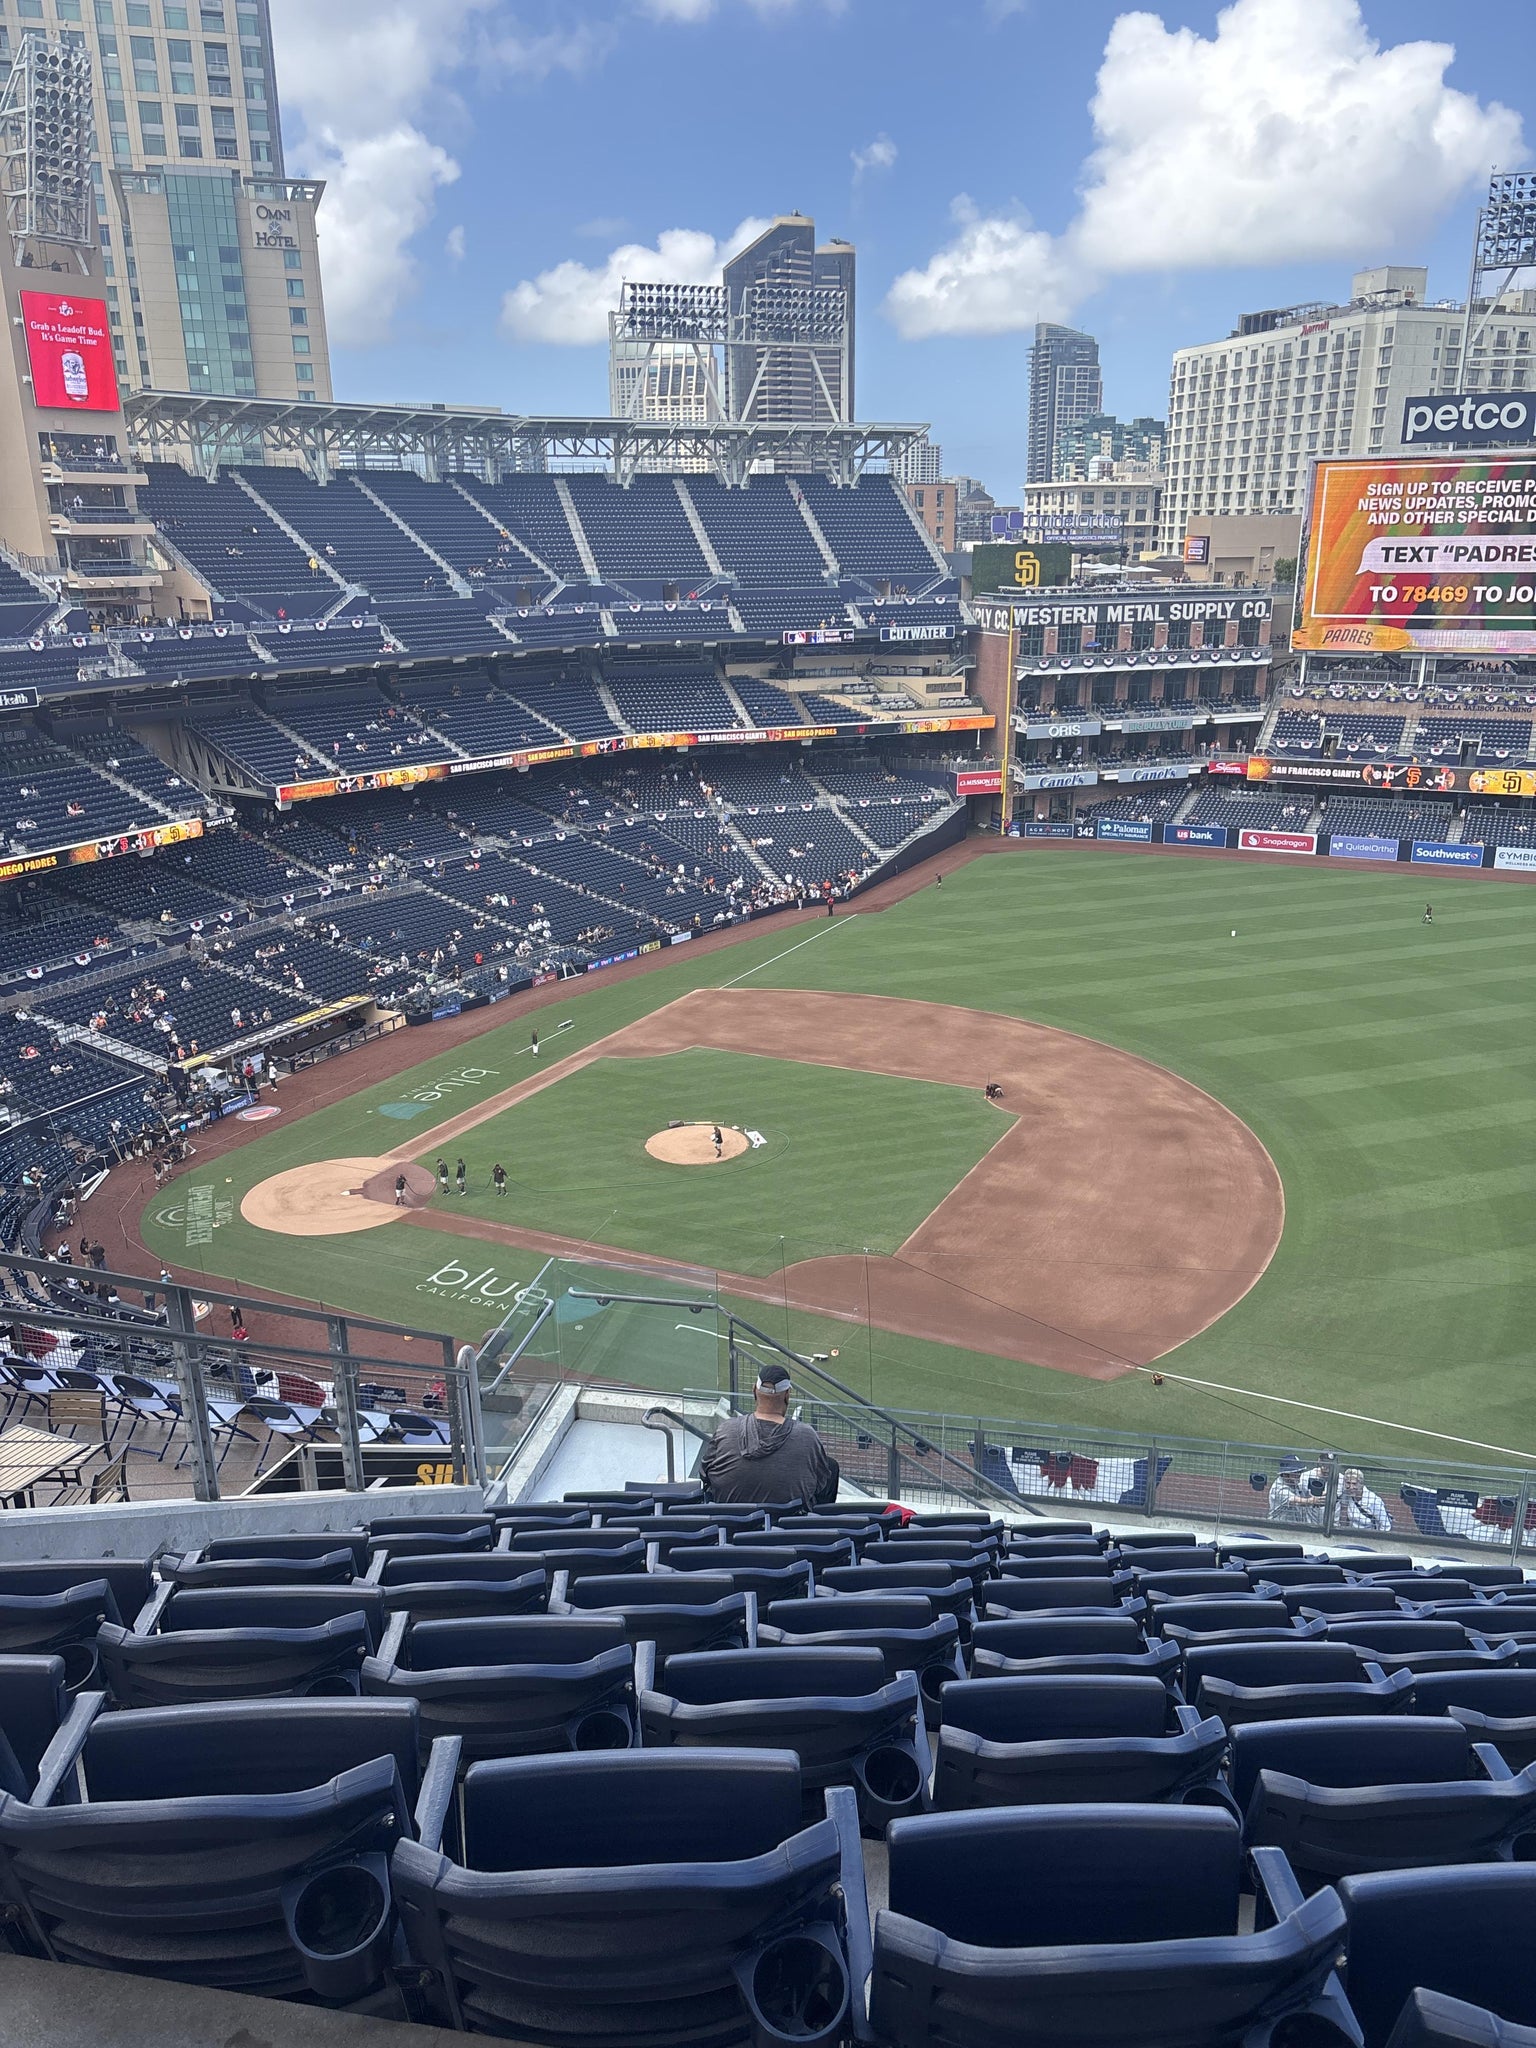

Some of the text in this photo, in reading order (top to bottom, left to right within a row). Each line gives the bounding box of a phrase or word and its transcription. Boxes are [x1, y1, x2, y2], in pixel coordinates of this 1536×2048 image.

[256, 204, 291, 221] OMNI
[255, 231, 297, 248] HOTEL
[30, 321, 49, 330] Grab
[58, 323, 86, 335] Leadoff
[55, 334, 76, 344] Game
[78, 336, 98, 346] Time
[1405, 397, 1527, 441] petco
[1367, 483, 1403, 496] SIGN
[1407, 482, 1428, 495] UP
[1431, 482, 1451, 494] TO
[1454, 480, 1522, 494] RECEIVE
[1358, 498, 1401, 512] NEWS
[1405, 496, 1479, 510] UPDATES,
[1028, 514, 1121, 529] QuidelOrtho
[1367, 512, 1400, 525] AND
[1403, 511, 1454, 524] OTHER
[1457, 510, 1524, 524] SPECIAL
[1381, 546, 1438, 562] TEXT
[1369, 586, 1536, 603] TO 78469 TO JO
[1013, 601, 1270, 626] WESTERN METAL SUPPLY CO.
[890, 627, 946, 640] CUTWATER
[1322, 628, 1374, 646] PADRES
[1496, 706, 1532, 714] LANDING
[1048, 724, 1081, 738] ORIS
[1272, 766, 1361, 779] SAN FRANCISCO GIANTS
[1078, 827, 1094, 837] 342
[1113, 824, 1148, 834] Palomar
[1190, 830, 1212, 840] bank
[1262, 837, 1308, 848] Snapdragon
[1346, 842, 1395, 854] QuidelOrtho
[1416, 848, 1470, 860] Southwest
[1499, 852, 1536, 862] CYMBI
[24, 856, 58, 872] PADRES
